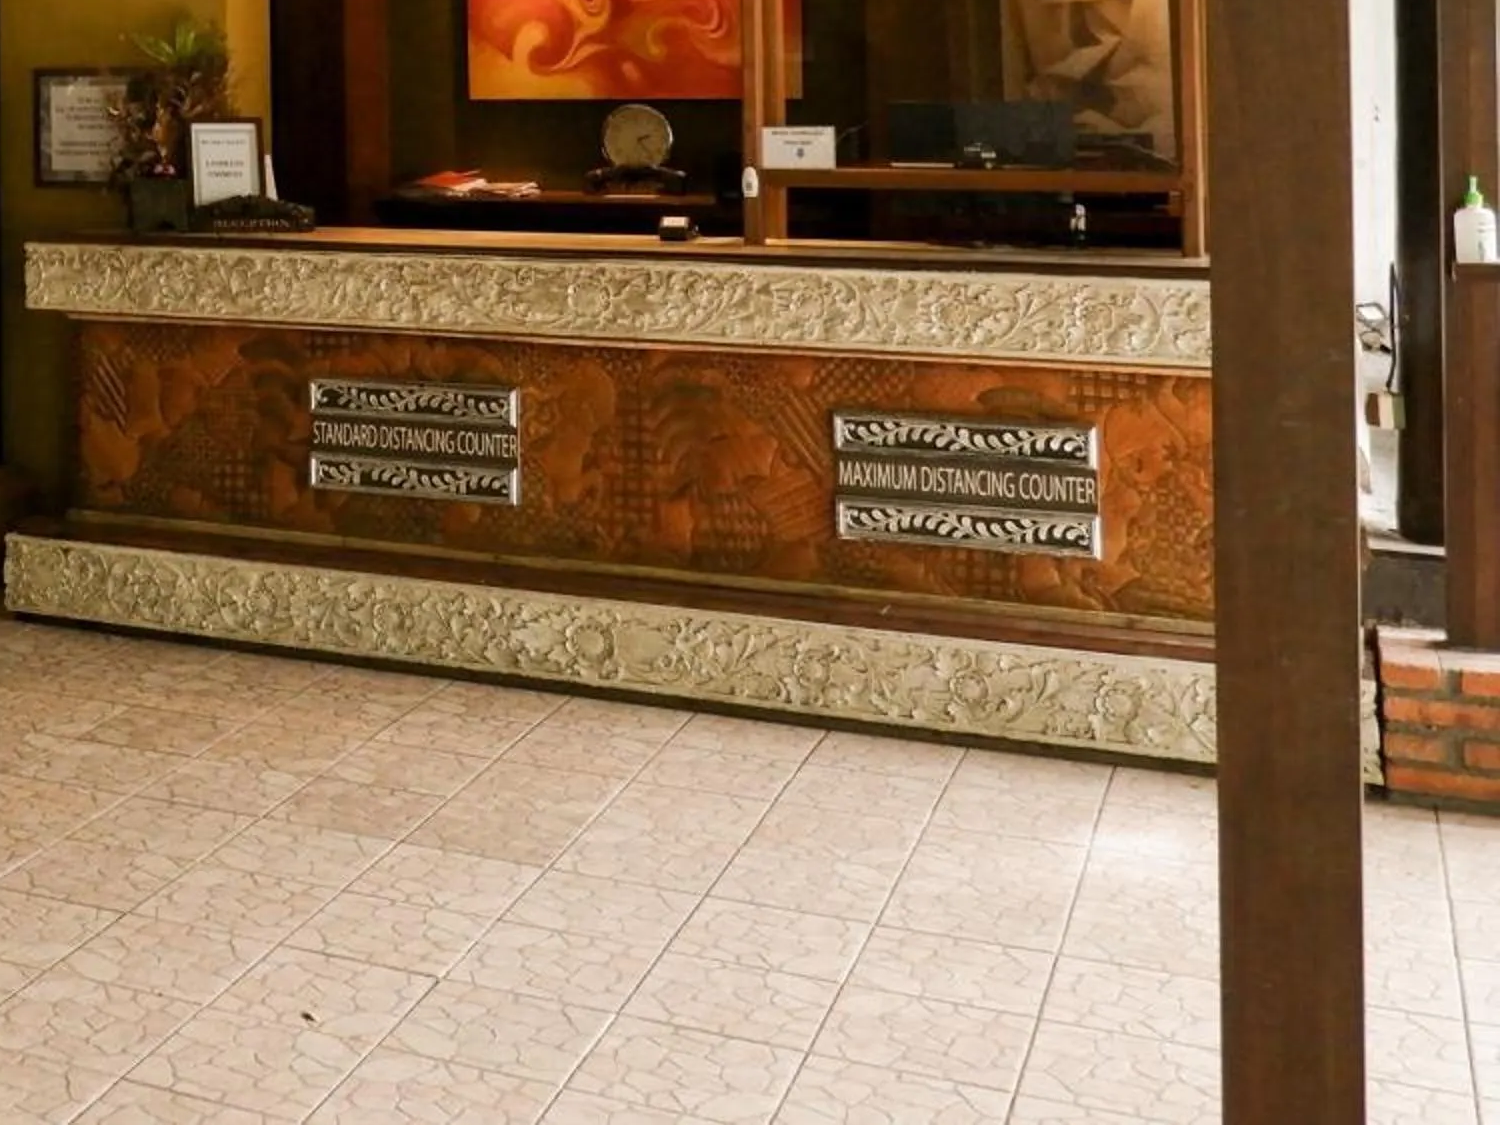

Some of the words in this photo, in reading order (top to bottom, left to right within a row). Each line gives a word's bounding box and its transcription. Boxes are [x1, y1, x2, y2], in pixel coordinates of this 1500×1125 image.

[313, 422, 377, 447] STANDARD
[379, 427, 455, 453] DISTANCING
[457, 432, 518, 457] COUNTER
[839, 461, 917, 491] MAXIMUM
[921, 466, 1015, 498] DISTANCING
[1019, 473, 1096, 504] COUNTER
